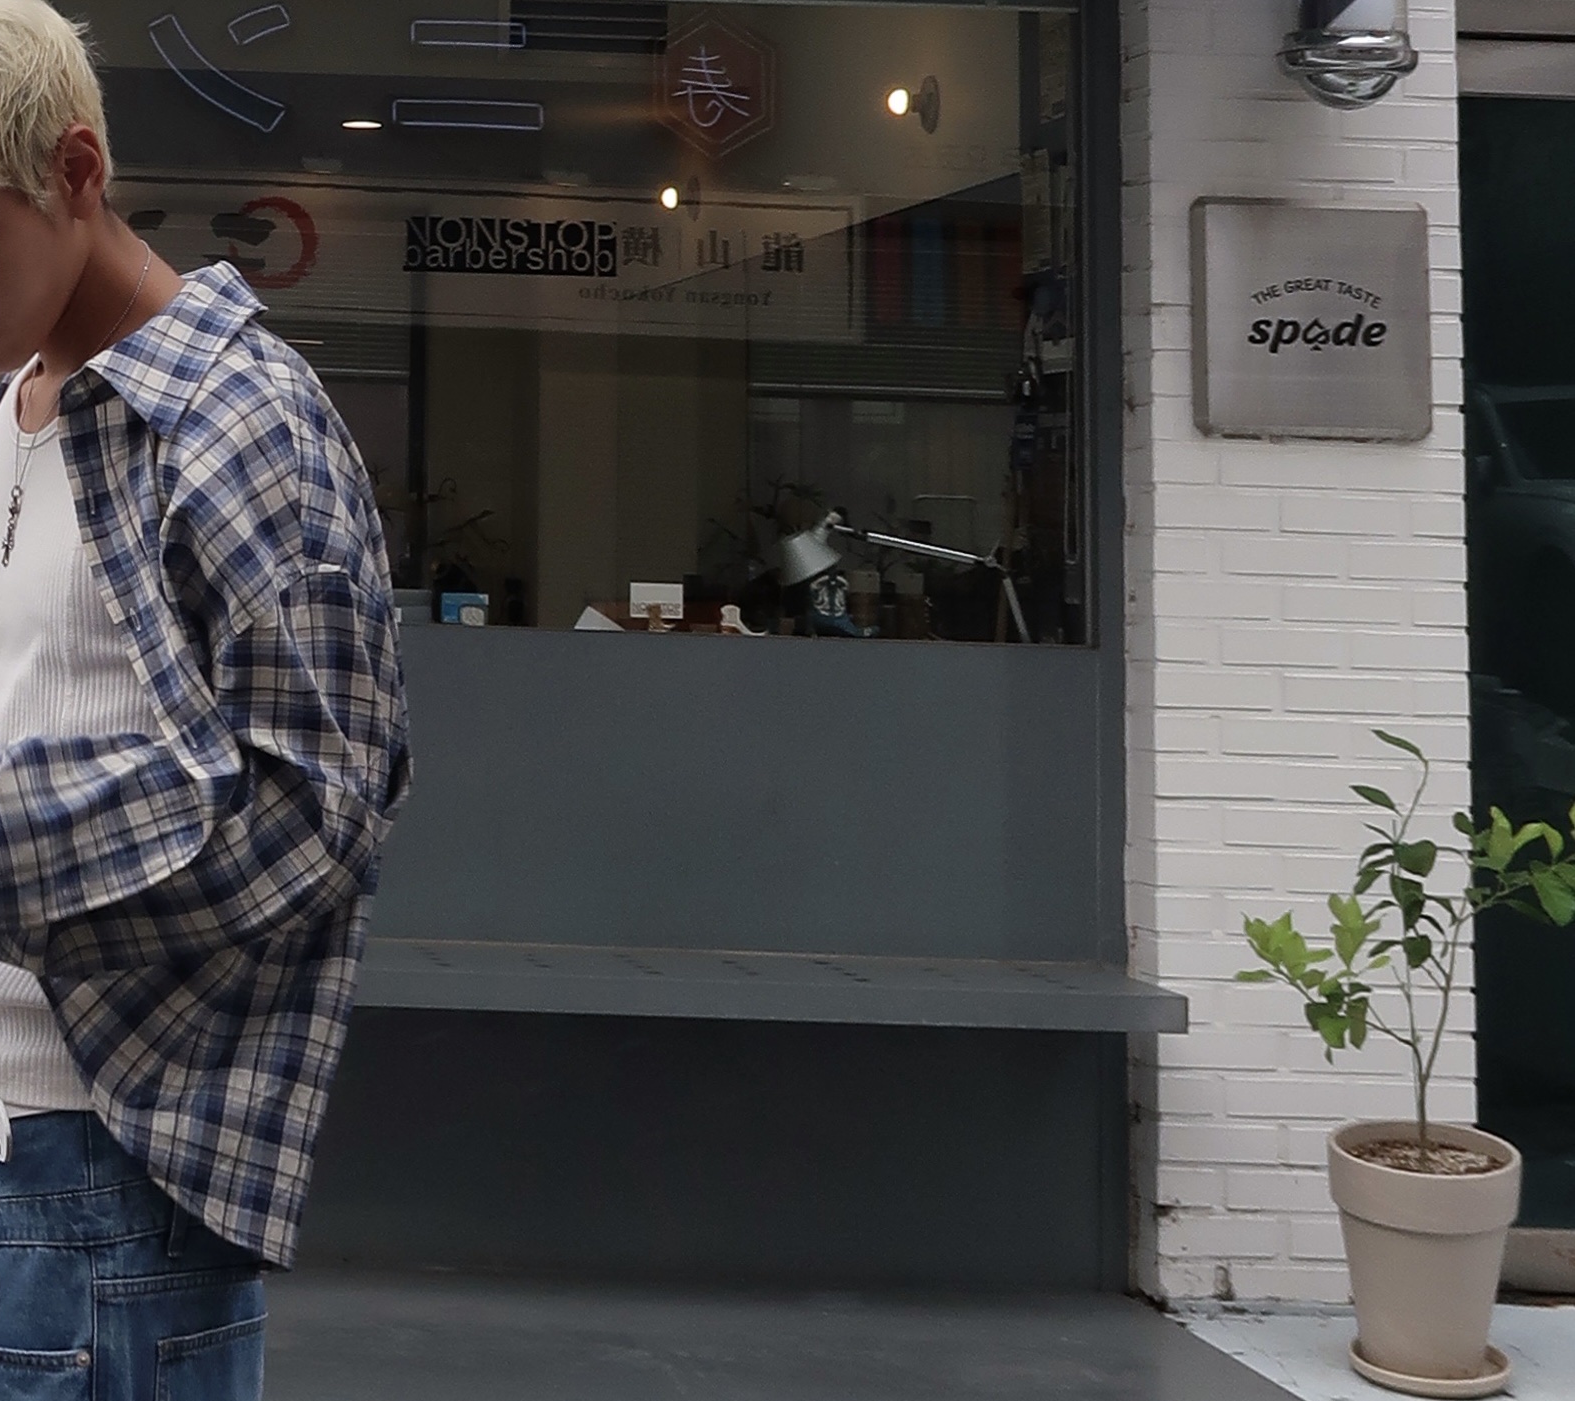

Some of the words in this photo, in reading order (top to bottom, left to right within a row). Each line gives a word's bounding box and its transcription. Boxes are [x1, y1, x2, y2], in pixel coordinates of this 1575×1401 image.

[406, 216, 617, 251] NONSTOP
[405, 237, 615, 276] barbershop
[1251, 285, 1281, 304] THE
[1283, 278, 1332, 294] GREAT
[1337, 281, 1382, 309] TASTE
[1247, 313, 1387, 354] spade
